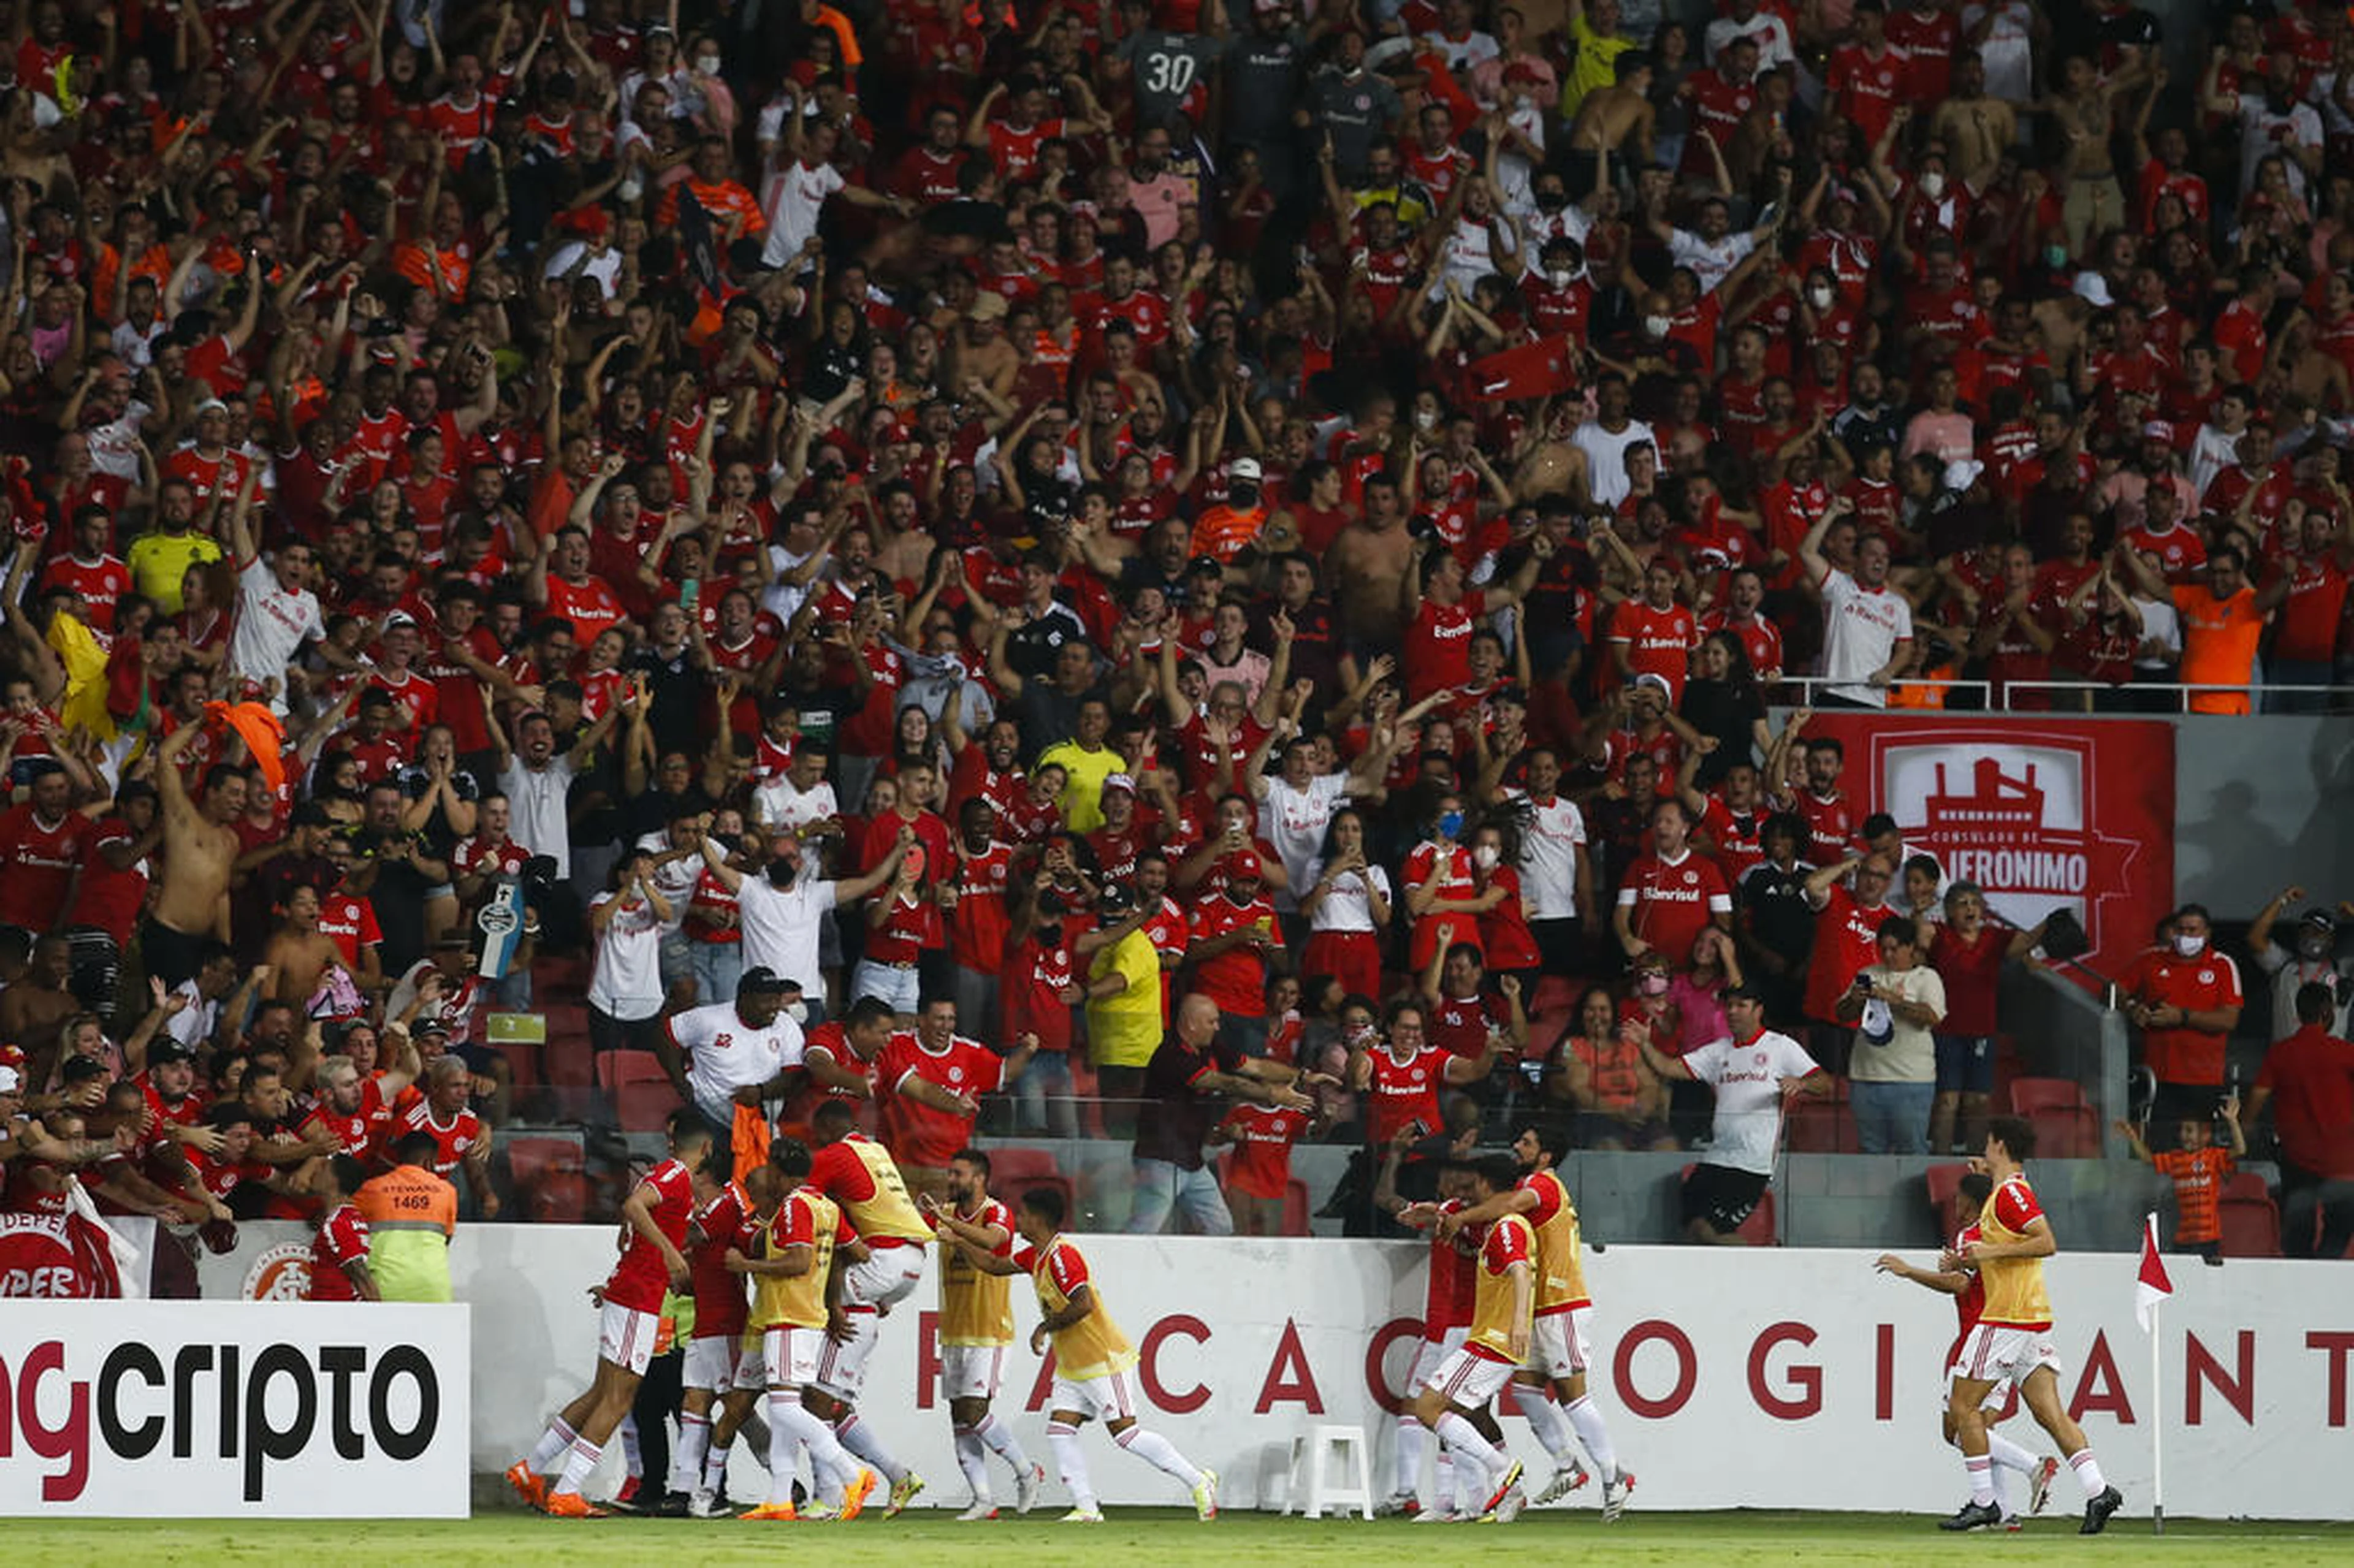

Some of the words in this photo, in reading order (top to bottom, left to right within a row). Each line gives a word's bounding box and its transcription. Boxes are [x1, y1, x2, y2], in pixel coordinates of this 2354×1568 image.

[1148, 53, 1195, 94] 30
[1932, 831, 2015, 843] CONSULADO
[2023, 831, 2040, 843] DE
[1643, 886, 1699, 902] Banrisul
[1727, 1071, 1769, 1083] Banrisul
[394, 1196, 430, 1209] 1469
